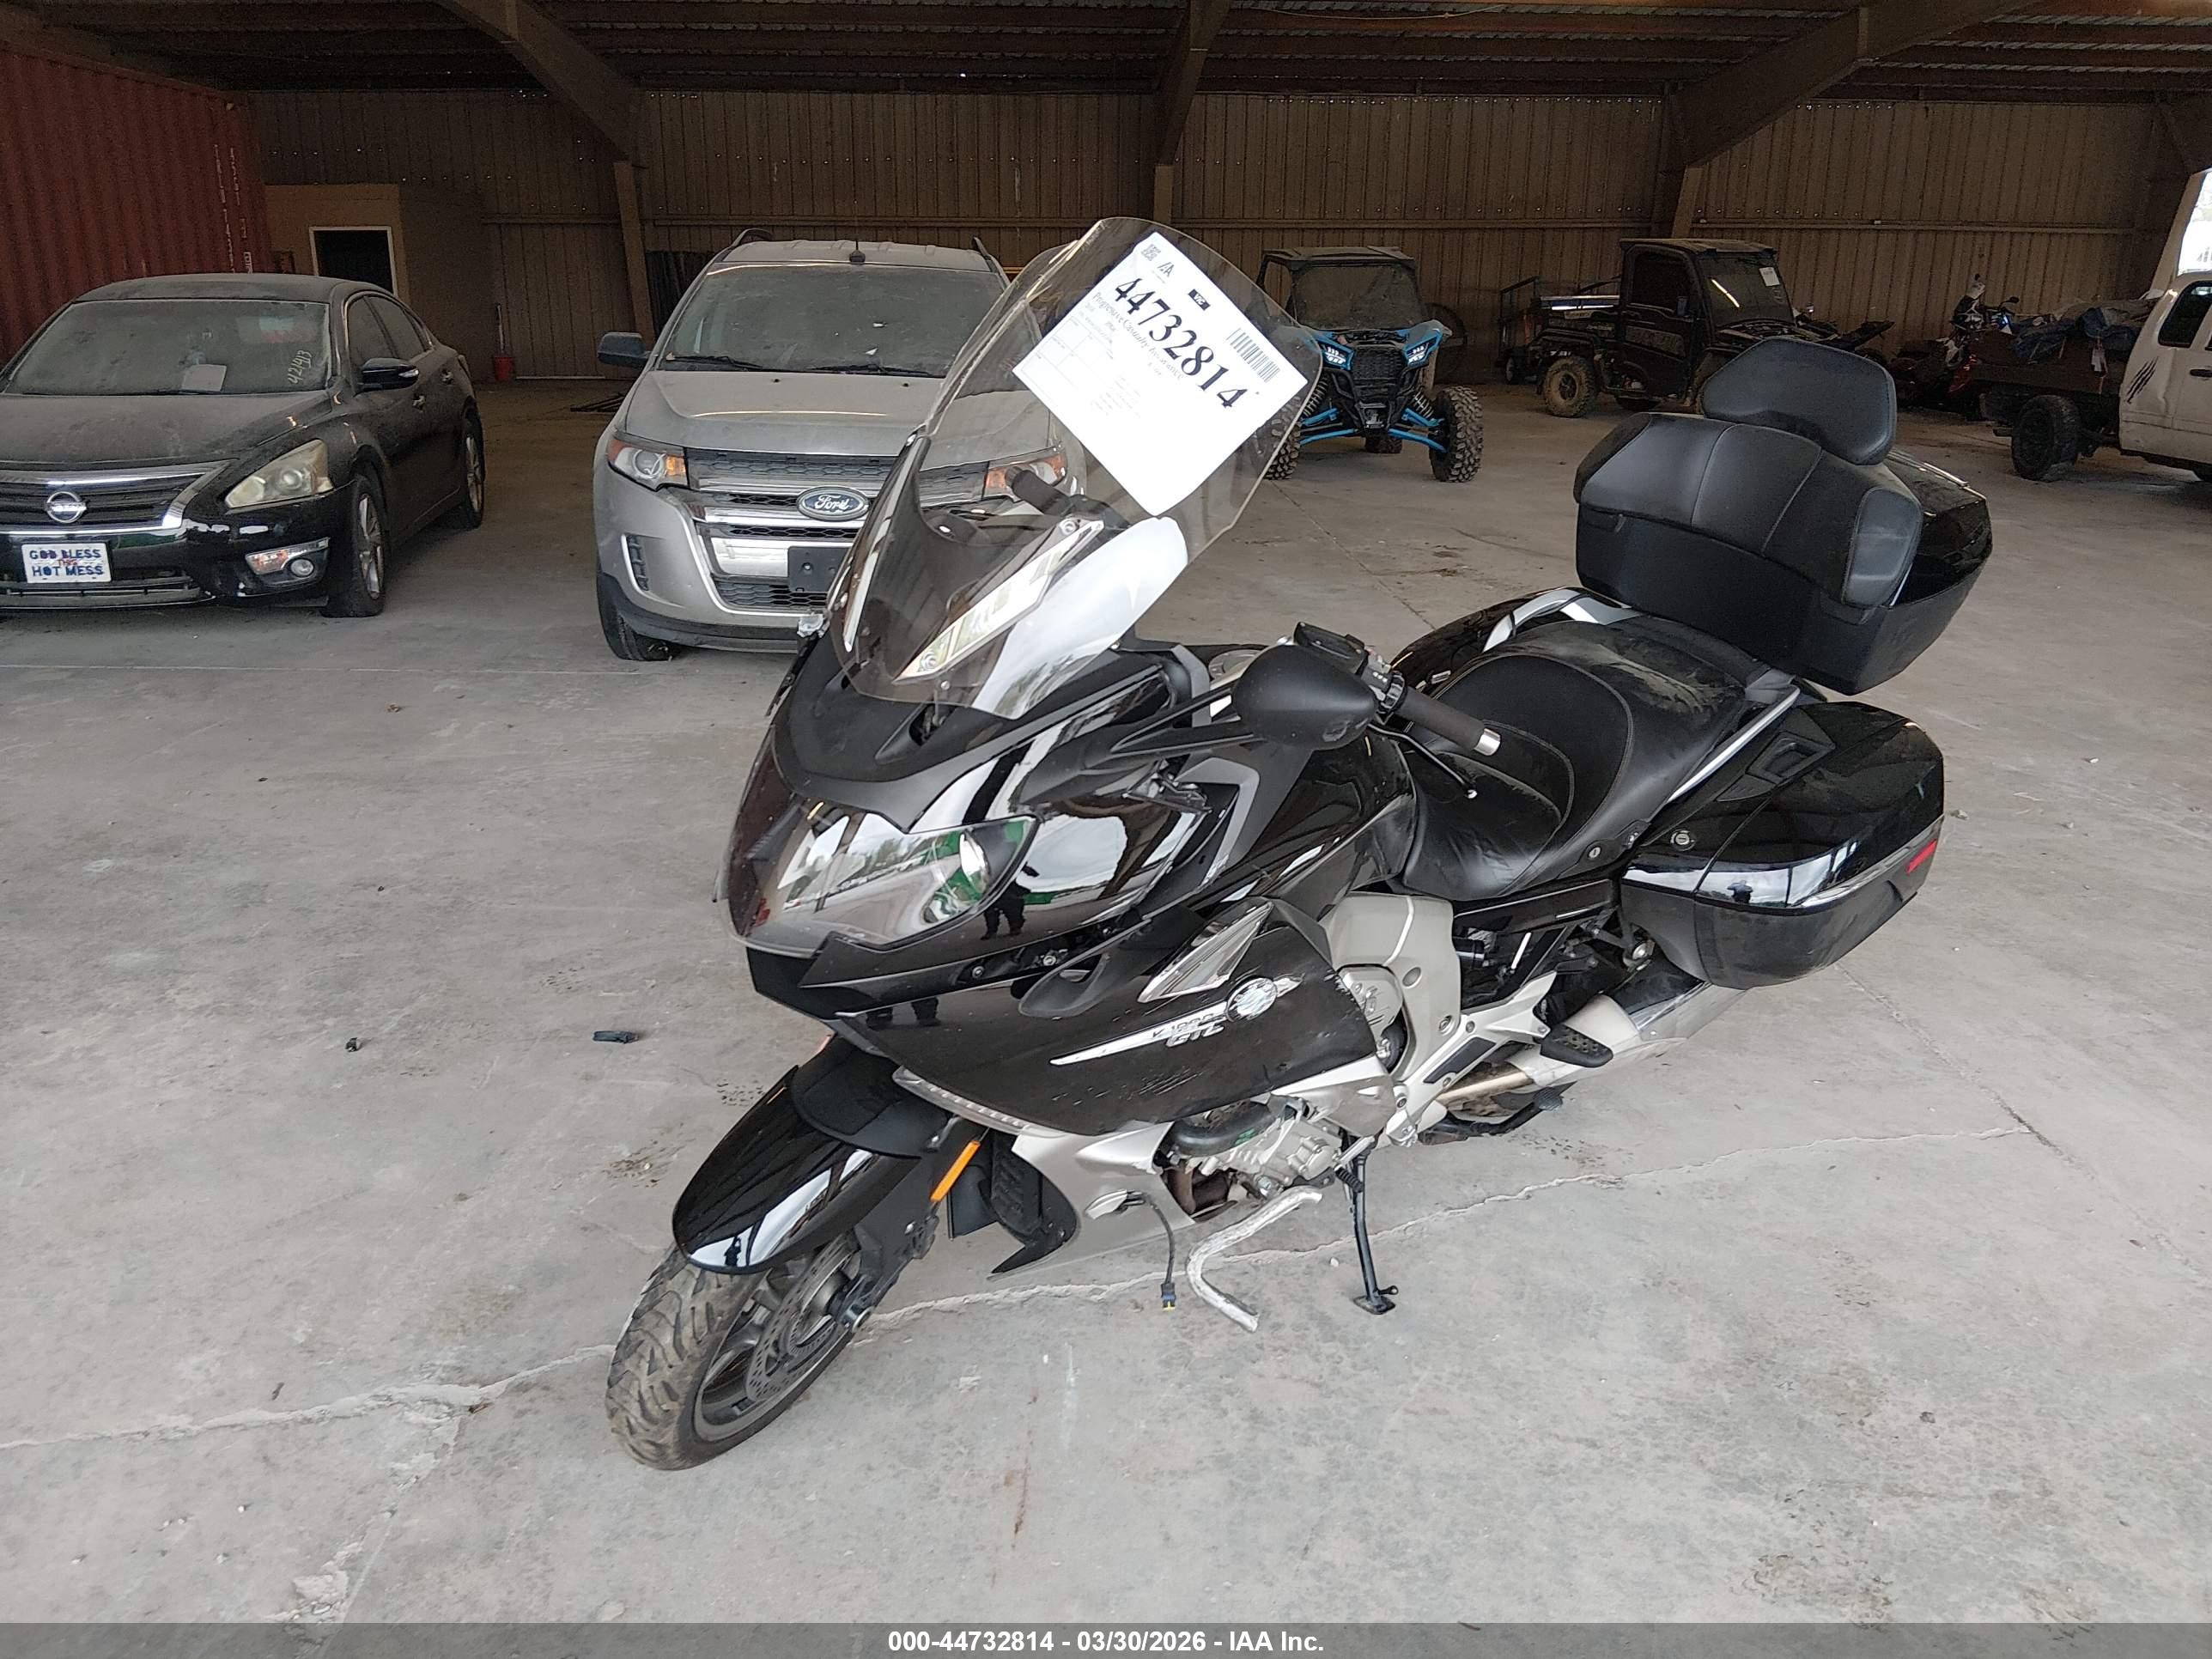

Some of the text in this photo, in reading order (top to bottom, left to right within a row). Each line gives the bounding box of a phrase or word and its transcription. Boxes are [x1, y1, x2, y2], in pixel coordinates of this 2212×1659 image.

[1115, 277, 1249, 409] 44732814
[814, 494, 850, 510] Ford
[30, 550, 57, 559] GOD
[32, 566, 104, 576] HOT MESS
